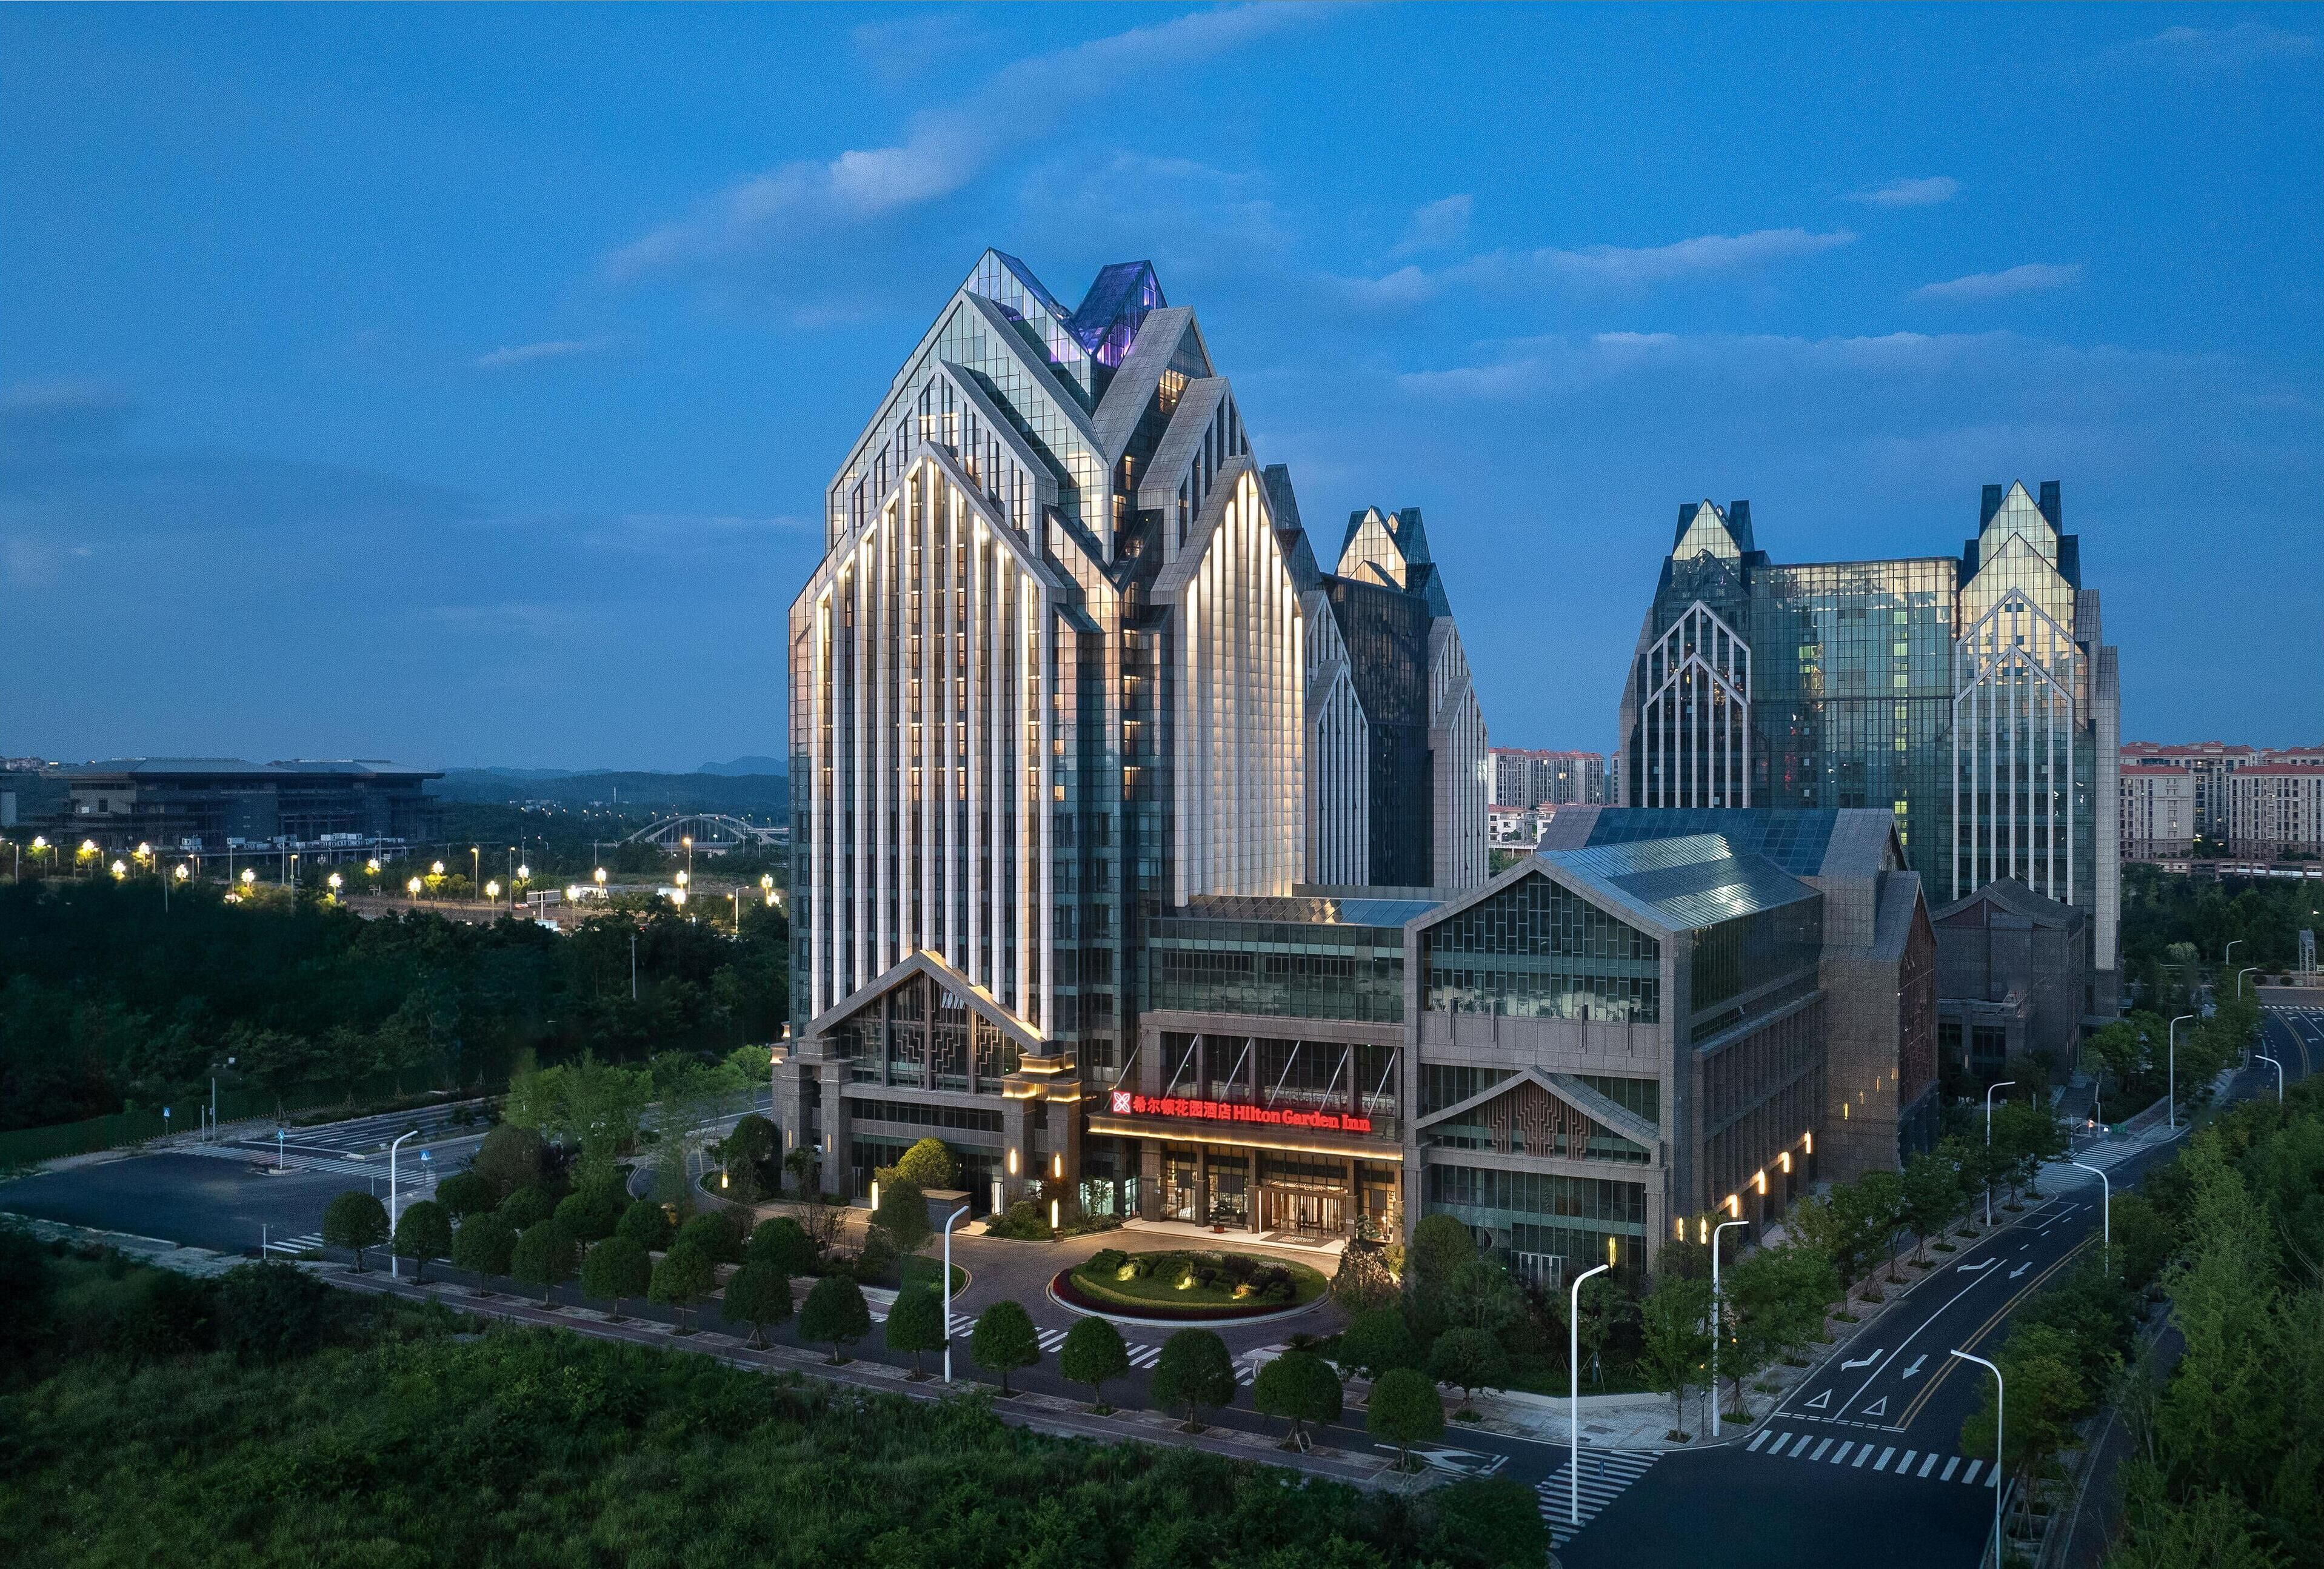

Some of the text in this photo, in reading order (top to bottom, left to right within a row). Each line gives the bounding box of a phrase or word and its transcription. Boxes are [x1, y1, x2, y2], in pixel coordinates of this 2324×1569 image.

[1133, 1096, 1231, 1120] 希尔顿花园酒店
[1233, 1105, 1371, 1131] Hilton Garden Inn
